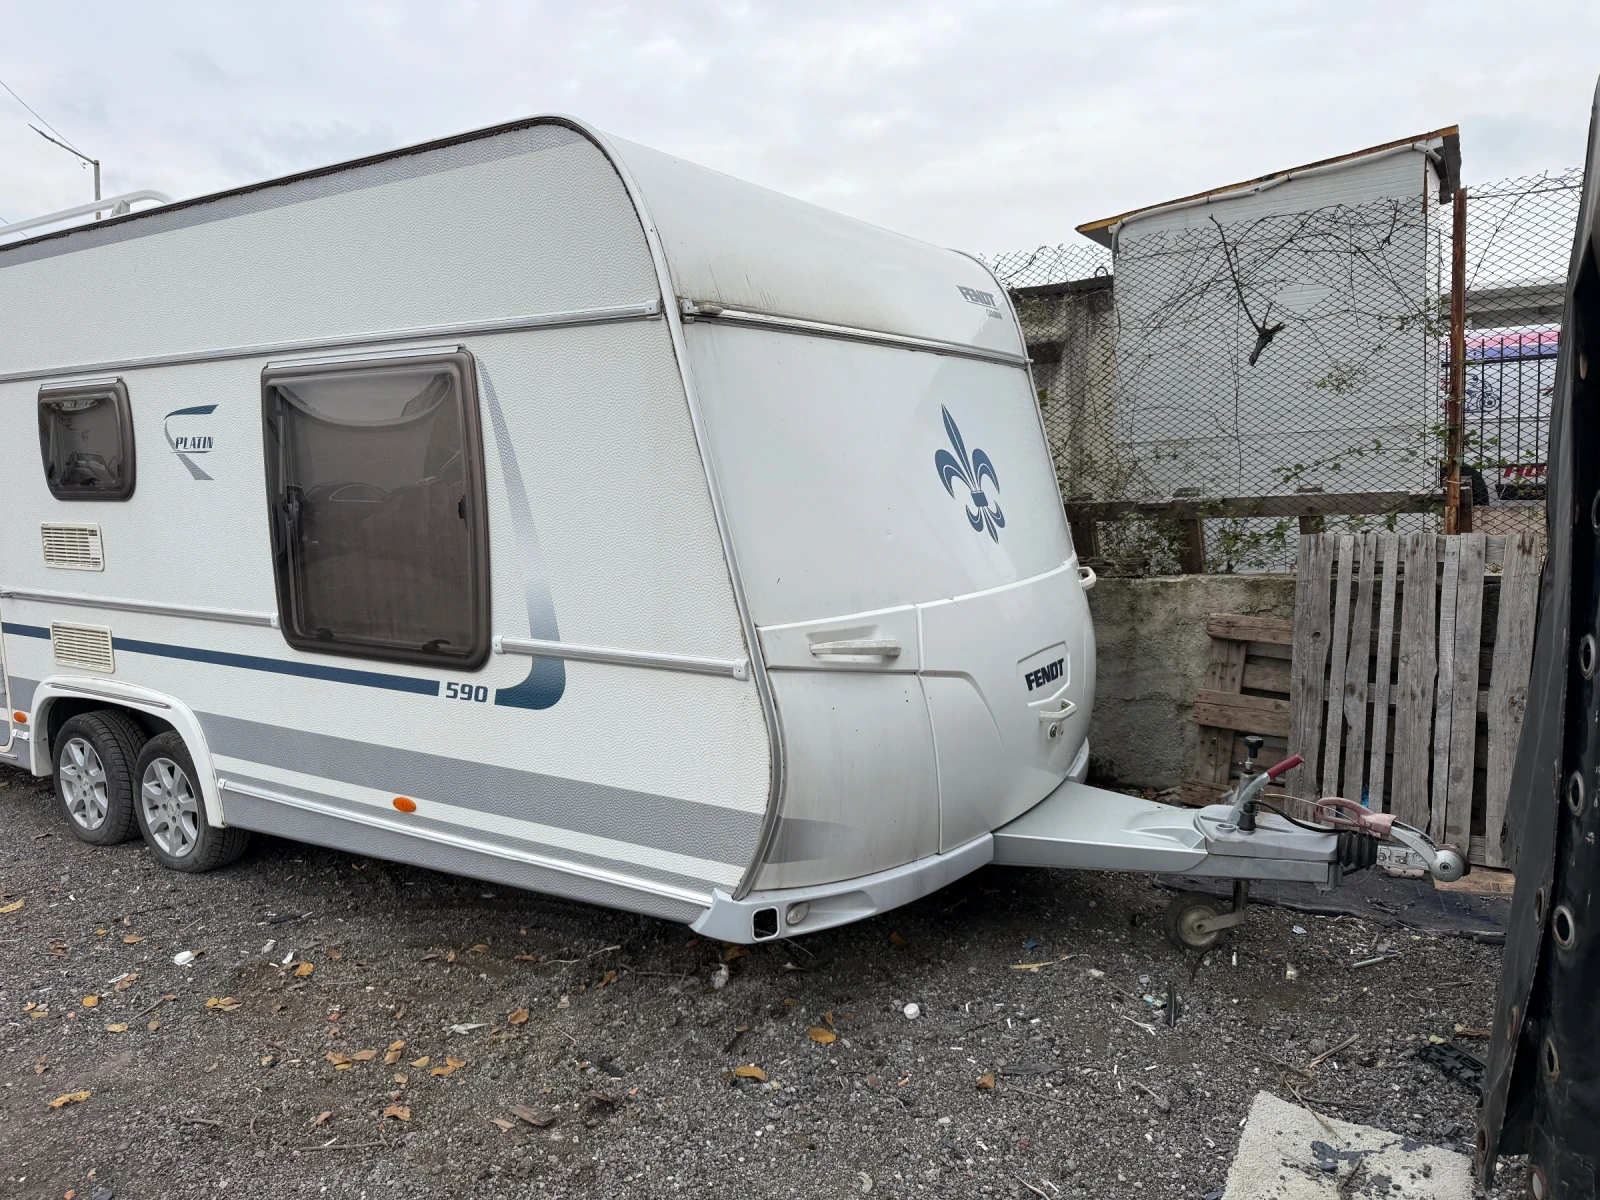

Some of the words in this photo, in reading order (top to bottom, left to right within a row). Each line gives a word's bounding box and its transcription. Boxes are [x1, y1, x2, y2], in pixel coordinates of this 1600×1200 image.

[956, 285, 997, 308] FENDT
[175, 436, 213, 449] PLATIN
[1024, 657, 1064, 692] FENDT
[445, 681, 488, 703] 590
